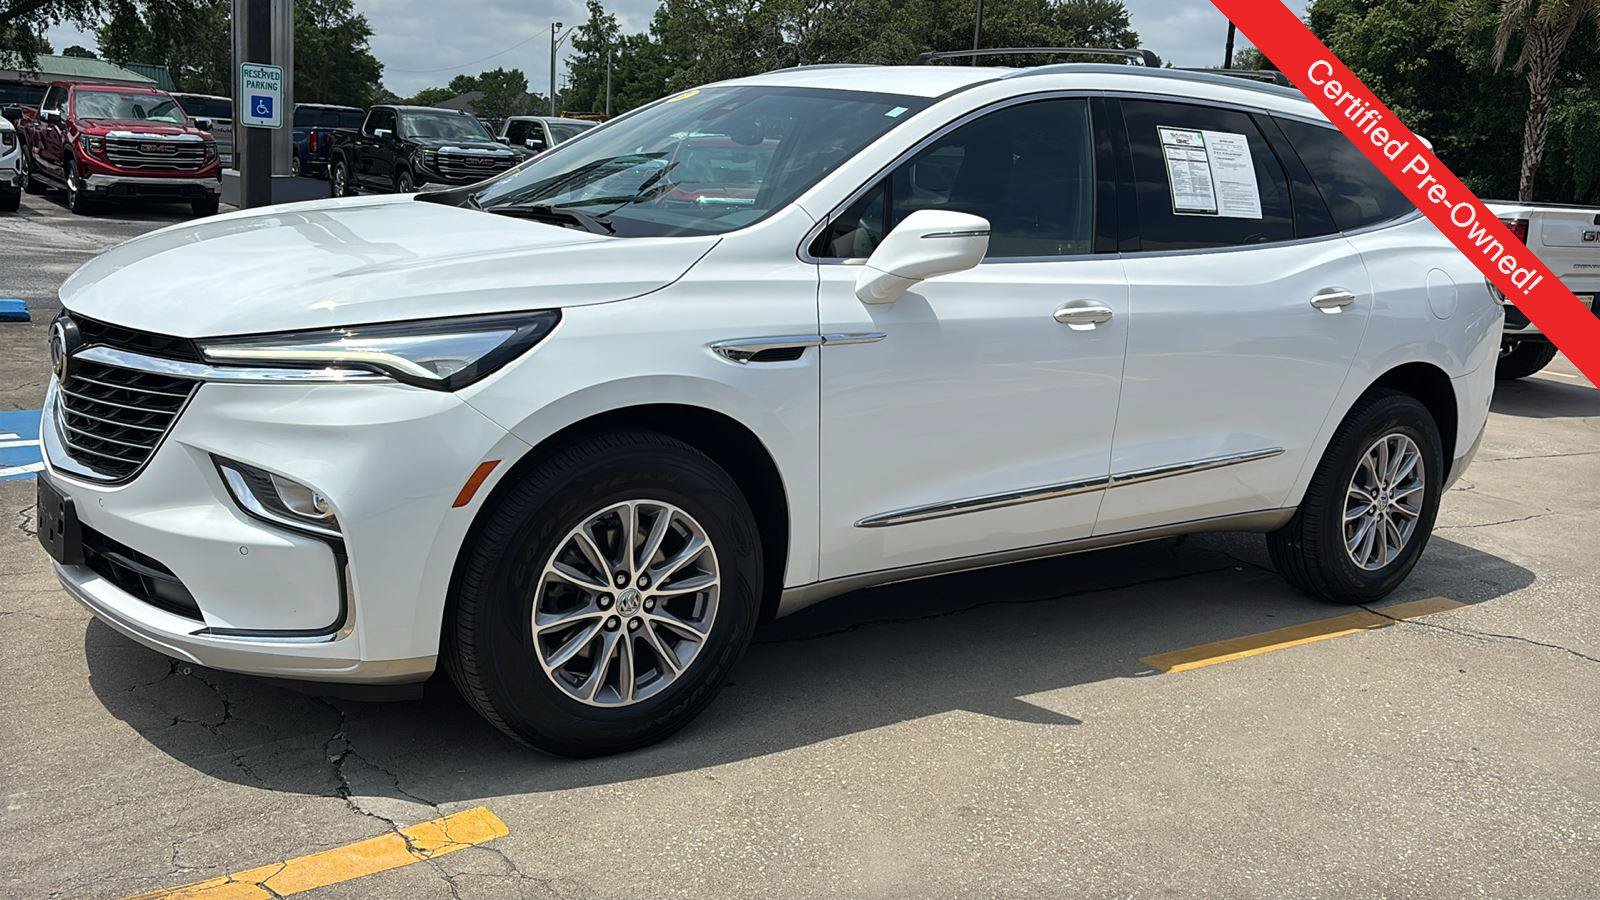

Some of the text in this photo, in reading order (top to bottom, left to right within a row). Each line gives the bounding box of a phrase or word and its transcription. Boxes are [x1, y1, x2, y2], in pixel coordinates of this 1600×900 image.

[243, 69, 280, 80] RESERVED
[246, 80, 278, 91] PARKING
[141, 144, 176, 152] GMC
[465, 157, 494, 165] GMC
